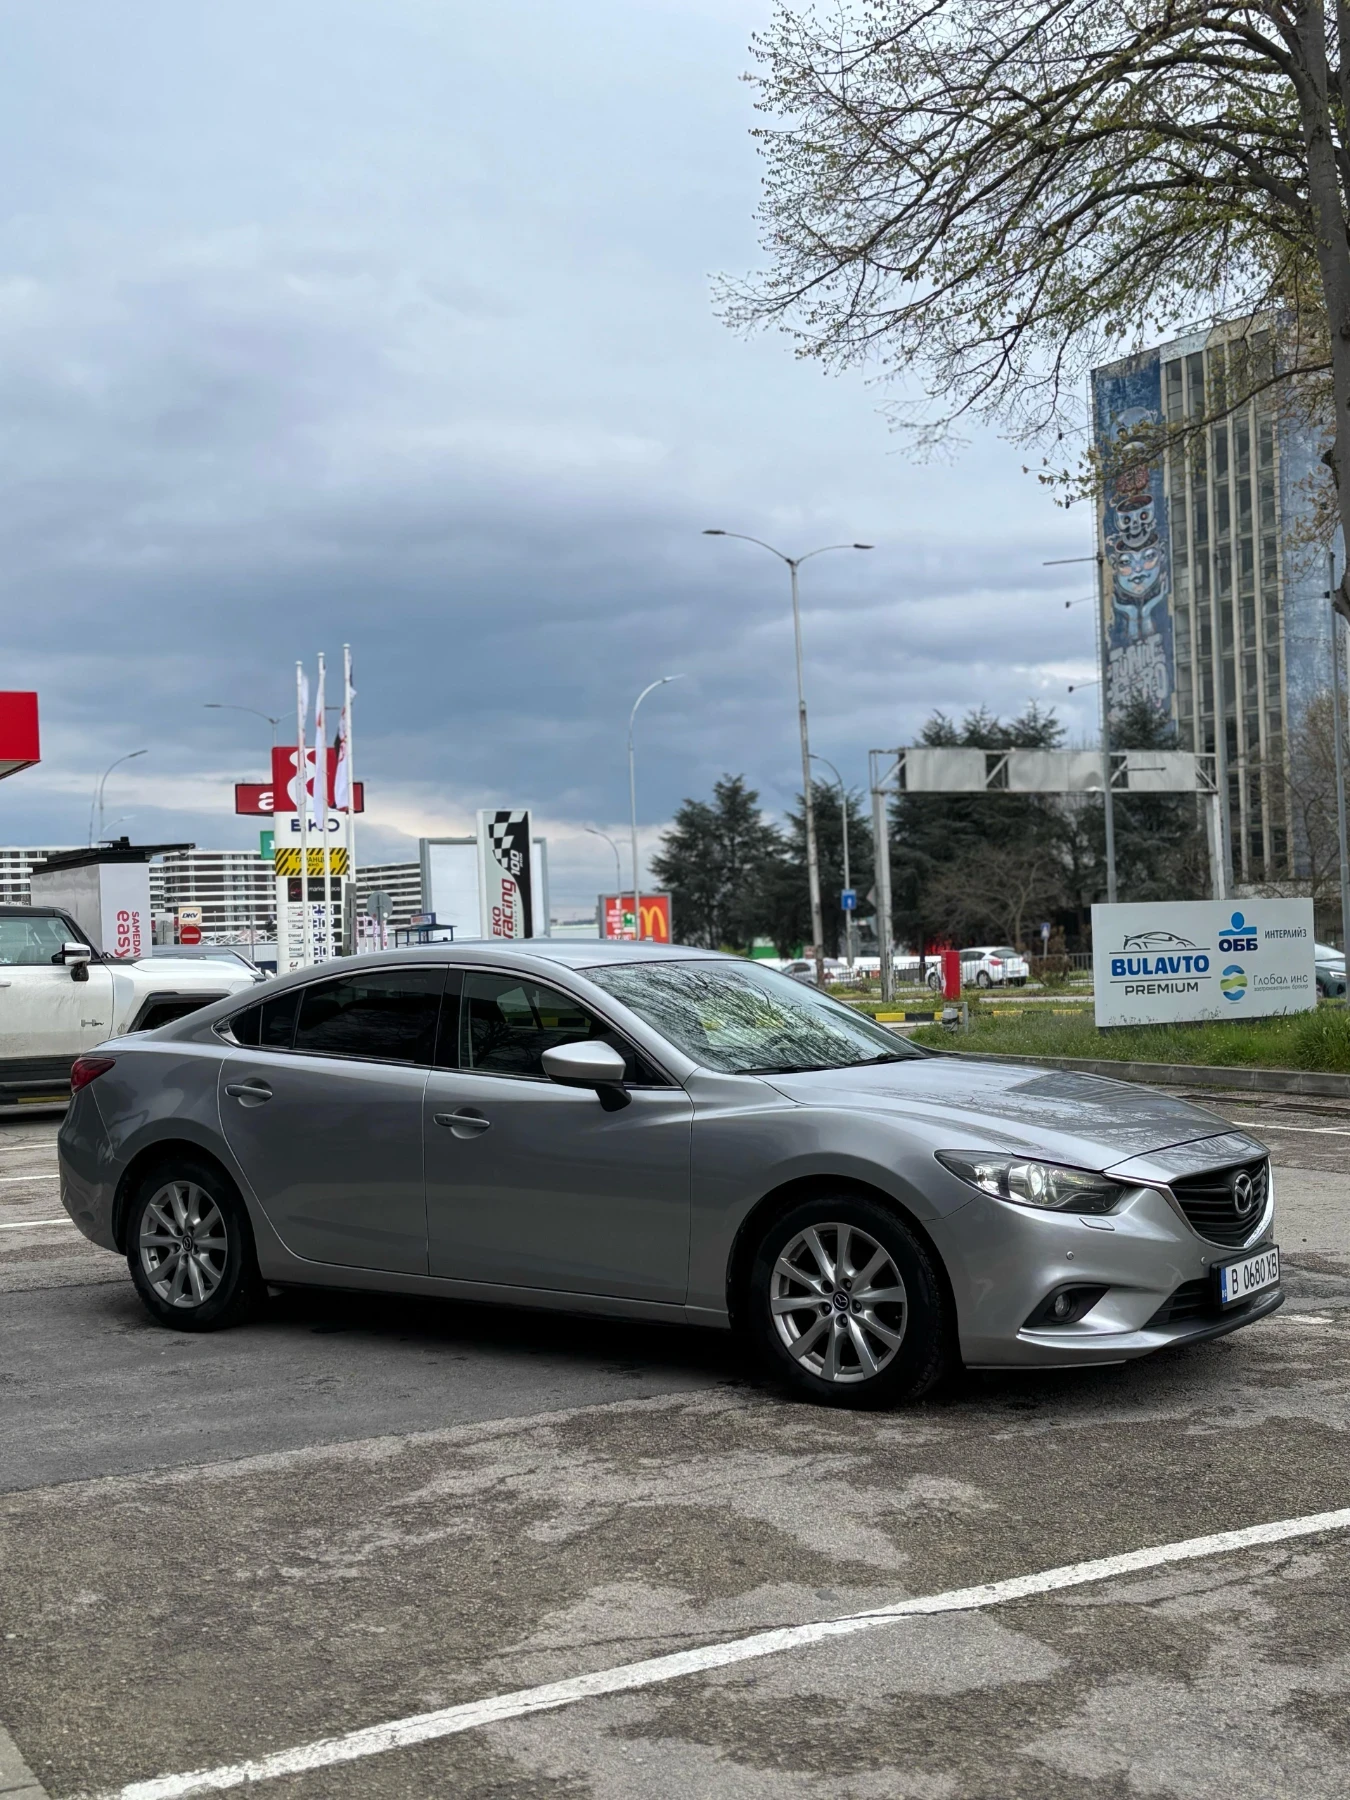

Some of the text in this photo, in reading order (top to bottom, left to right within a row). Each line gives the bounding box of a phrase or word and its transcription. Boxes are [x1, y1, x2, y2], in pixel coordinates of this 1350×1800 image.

[291, 818, 340, 832] EKO
[510, 849, 521, 876] 100
[502, 877, 517, 940] racing
[492, 906, 502, 936] EKO
[1264, 926, 1307, 939] ИНТЕРЛИЙЗ
[114, 910, 131, 958] easy
[1218, 937, 1259, 953] ОББ
[1111, 954, 1210, 977] BULAVTO
[1124, 981, 1199, 996] PREMIUM
[1253, 973, 1309, 986] Глобал инс
[1231, 1252, 1278, 1295] B 0680 XB
